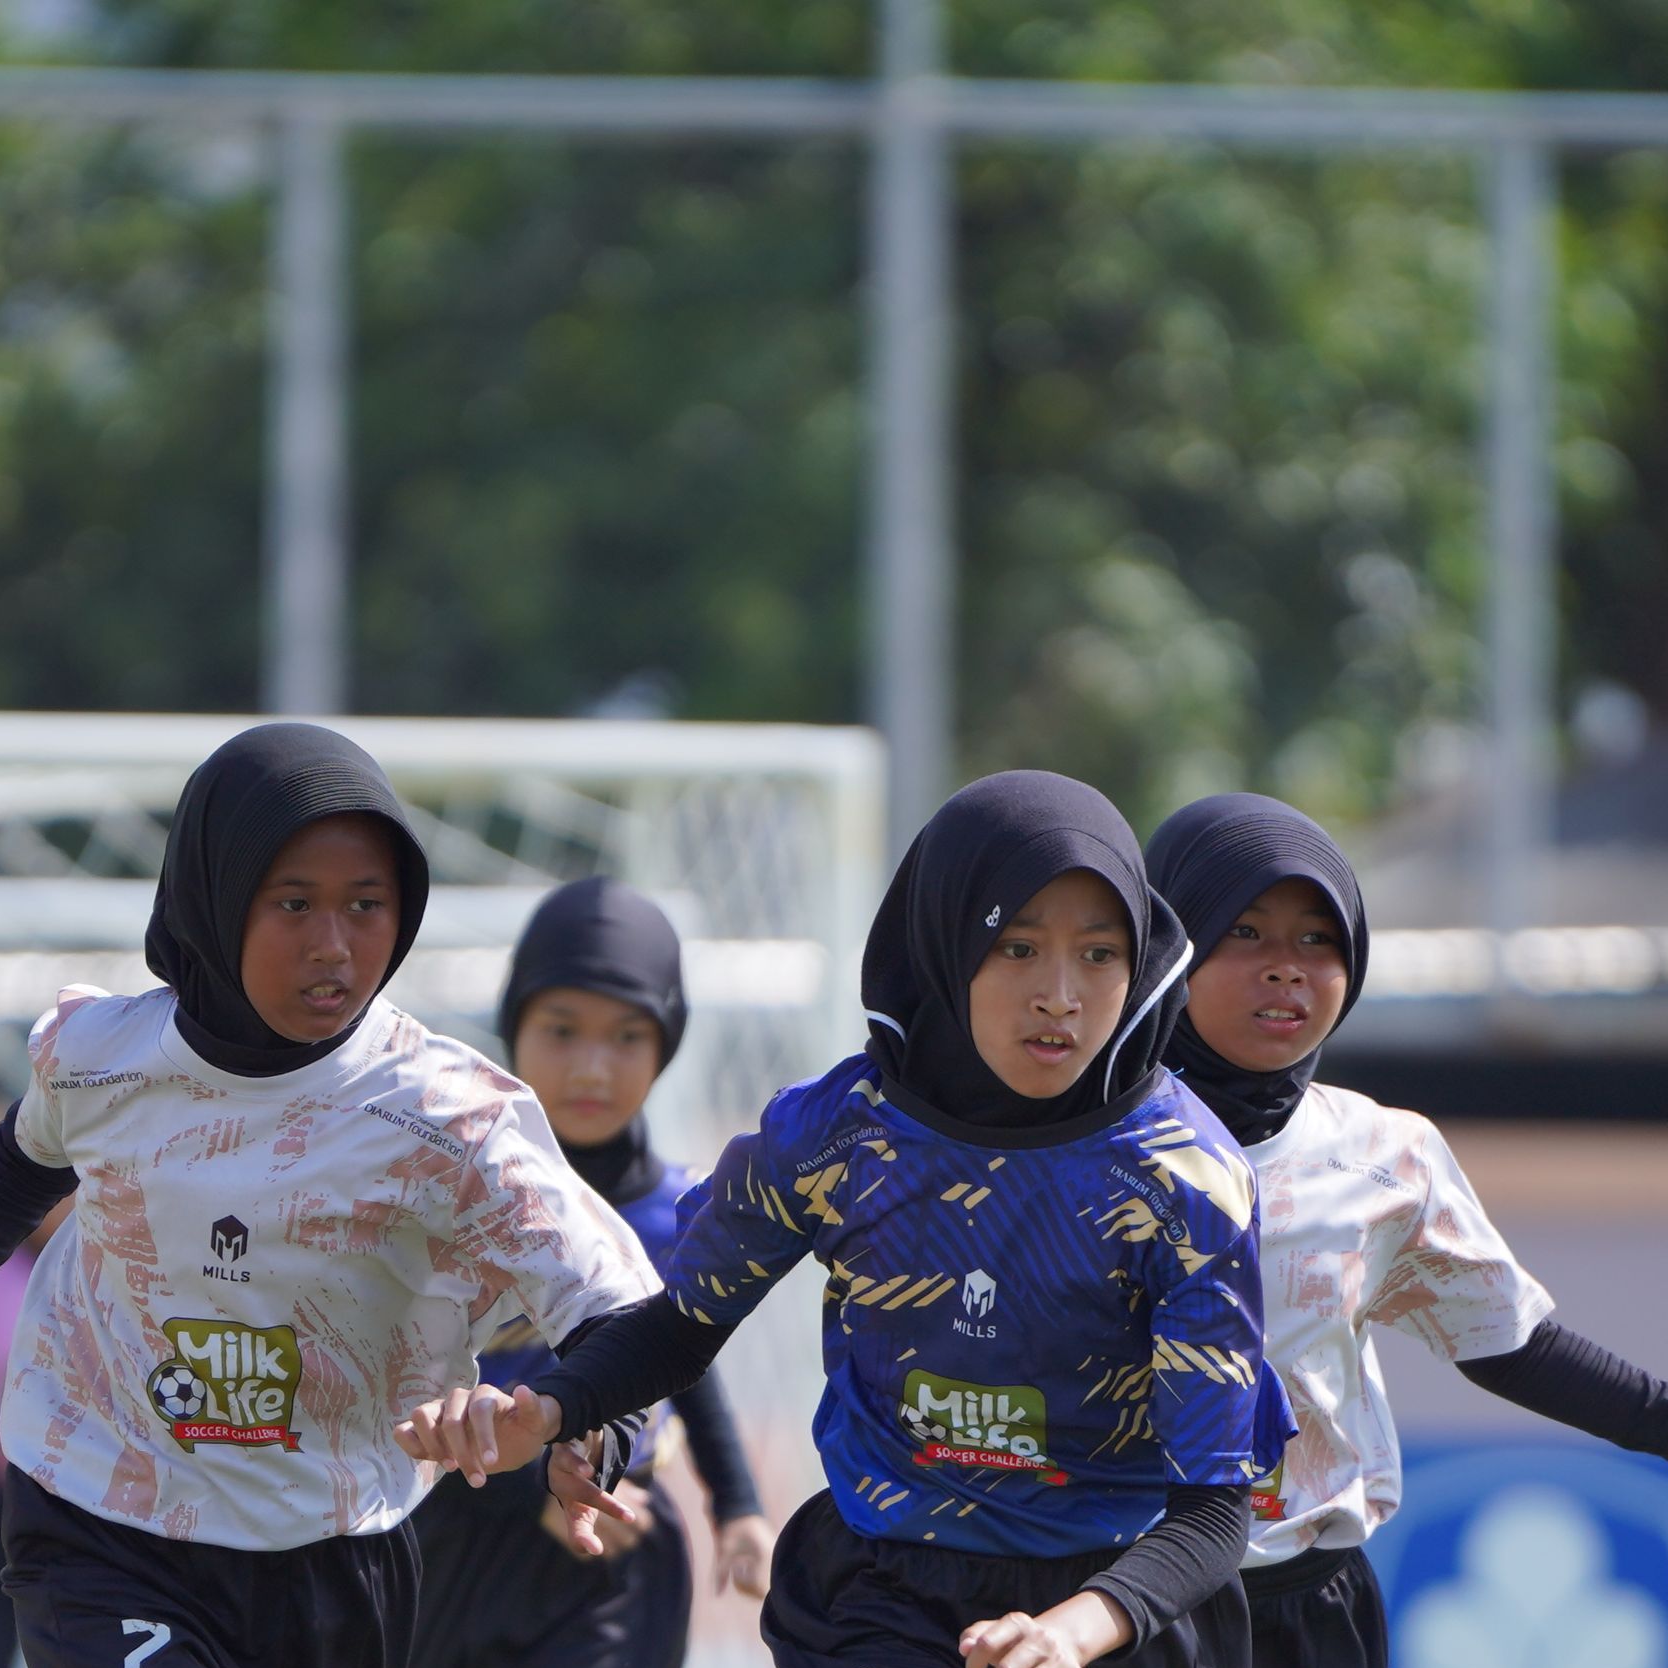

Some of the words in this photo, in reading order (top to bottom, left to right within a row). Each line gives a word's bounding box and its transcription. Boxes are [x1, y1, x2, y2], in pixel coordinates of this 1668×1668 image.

[83, 1071, 144, 1088] foundation
[407, 1120, 463, 1159] foundation
[836, 1126, 888, 1150] foundation
[203, 1265, 251, 1283] MILLS
[953, 1318, 997, 1339] MILLS
[177, 1330, 290, 1381] Milk
[205, 1379, 286, 1426] Life
[918, 1383, 1031, 1428] Milk
[184, 1426, 229, 1438] SOCCER
[231, 1429, 282, 1440] CHALLENGE
